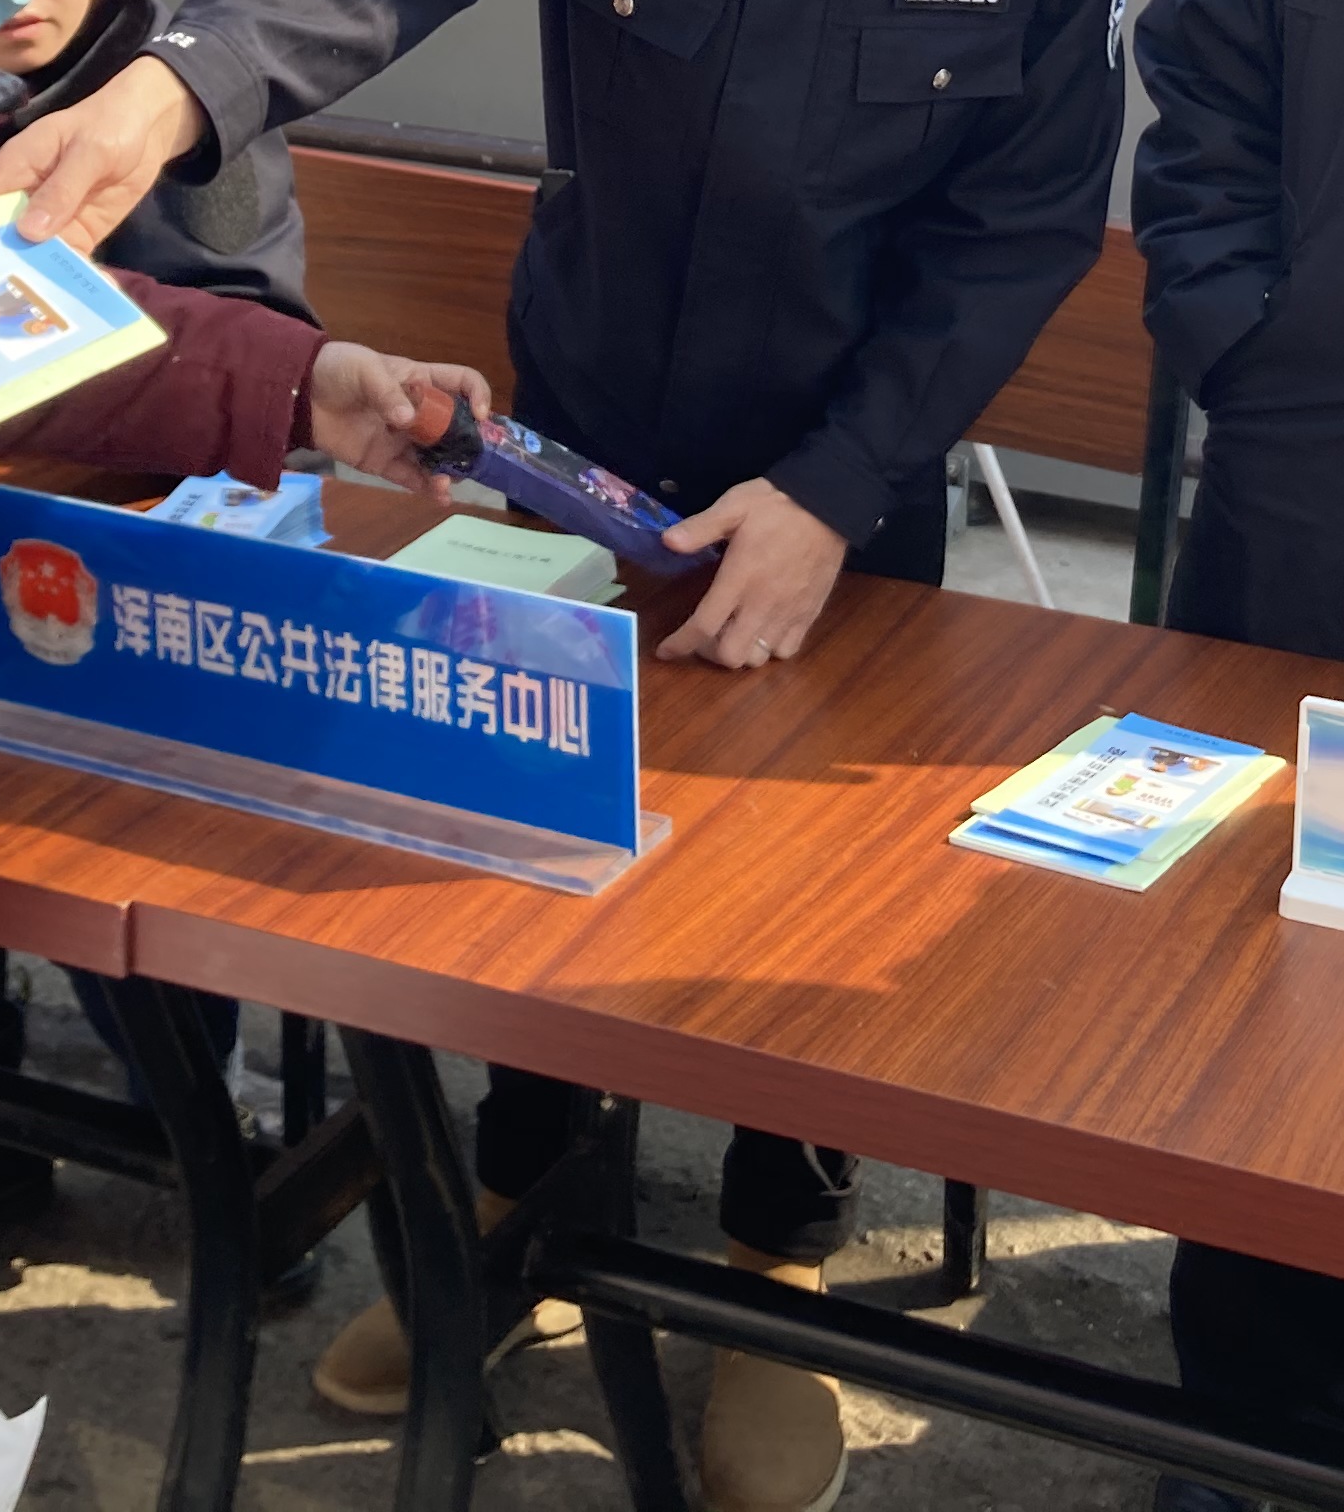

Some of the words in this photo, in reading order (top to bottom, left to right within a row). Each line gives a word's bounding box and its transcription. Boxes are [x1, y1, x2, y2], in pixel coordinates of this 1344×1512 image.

[112, 583, 590, 757] 浑南区公共法律服务中心
